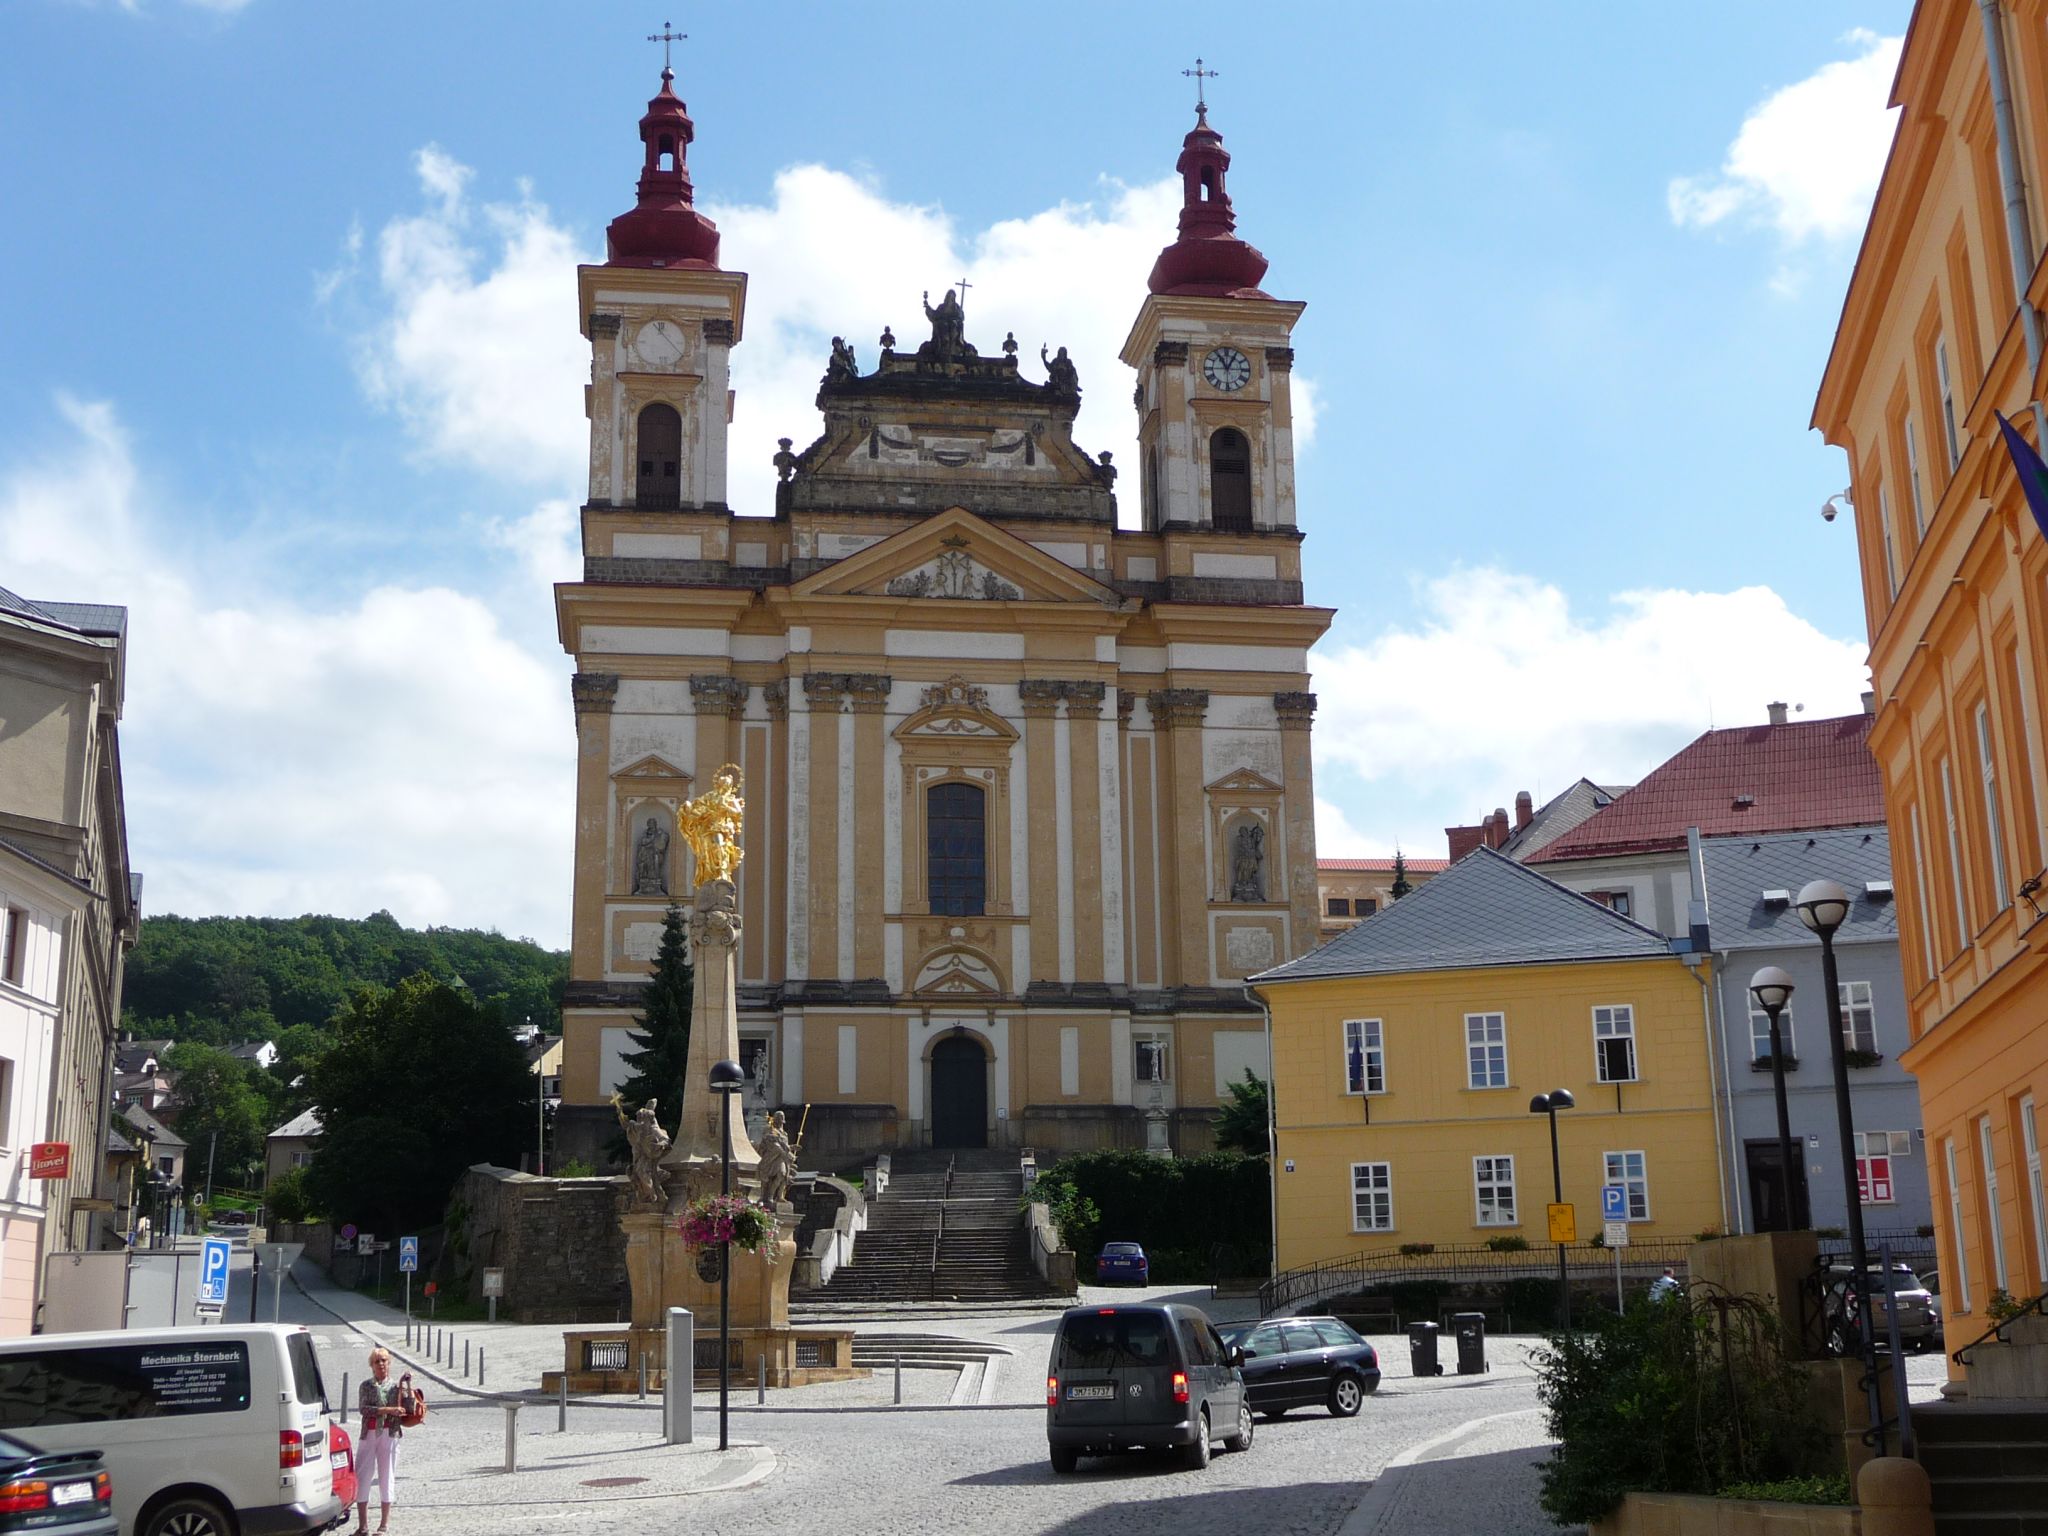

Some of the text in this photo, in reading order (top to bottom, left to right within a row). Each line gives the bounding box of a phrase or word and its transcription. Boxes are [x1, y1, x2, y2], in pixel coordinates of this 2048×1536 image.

[33, 1156, 64, 1171] Litovel
[1606, 1190, 1621, 1210] P
[206, 1247, 224, 1282] P
[141, 1351, 240, 1366] Mechanika Šternberk
